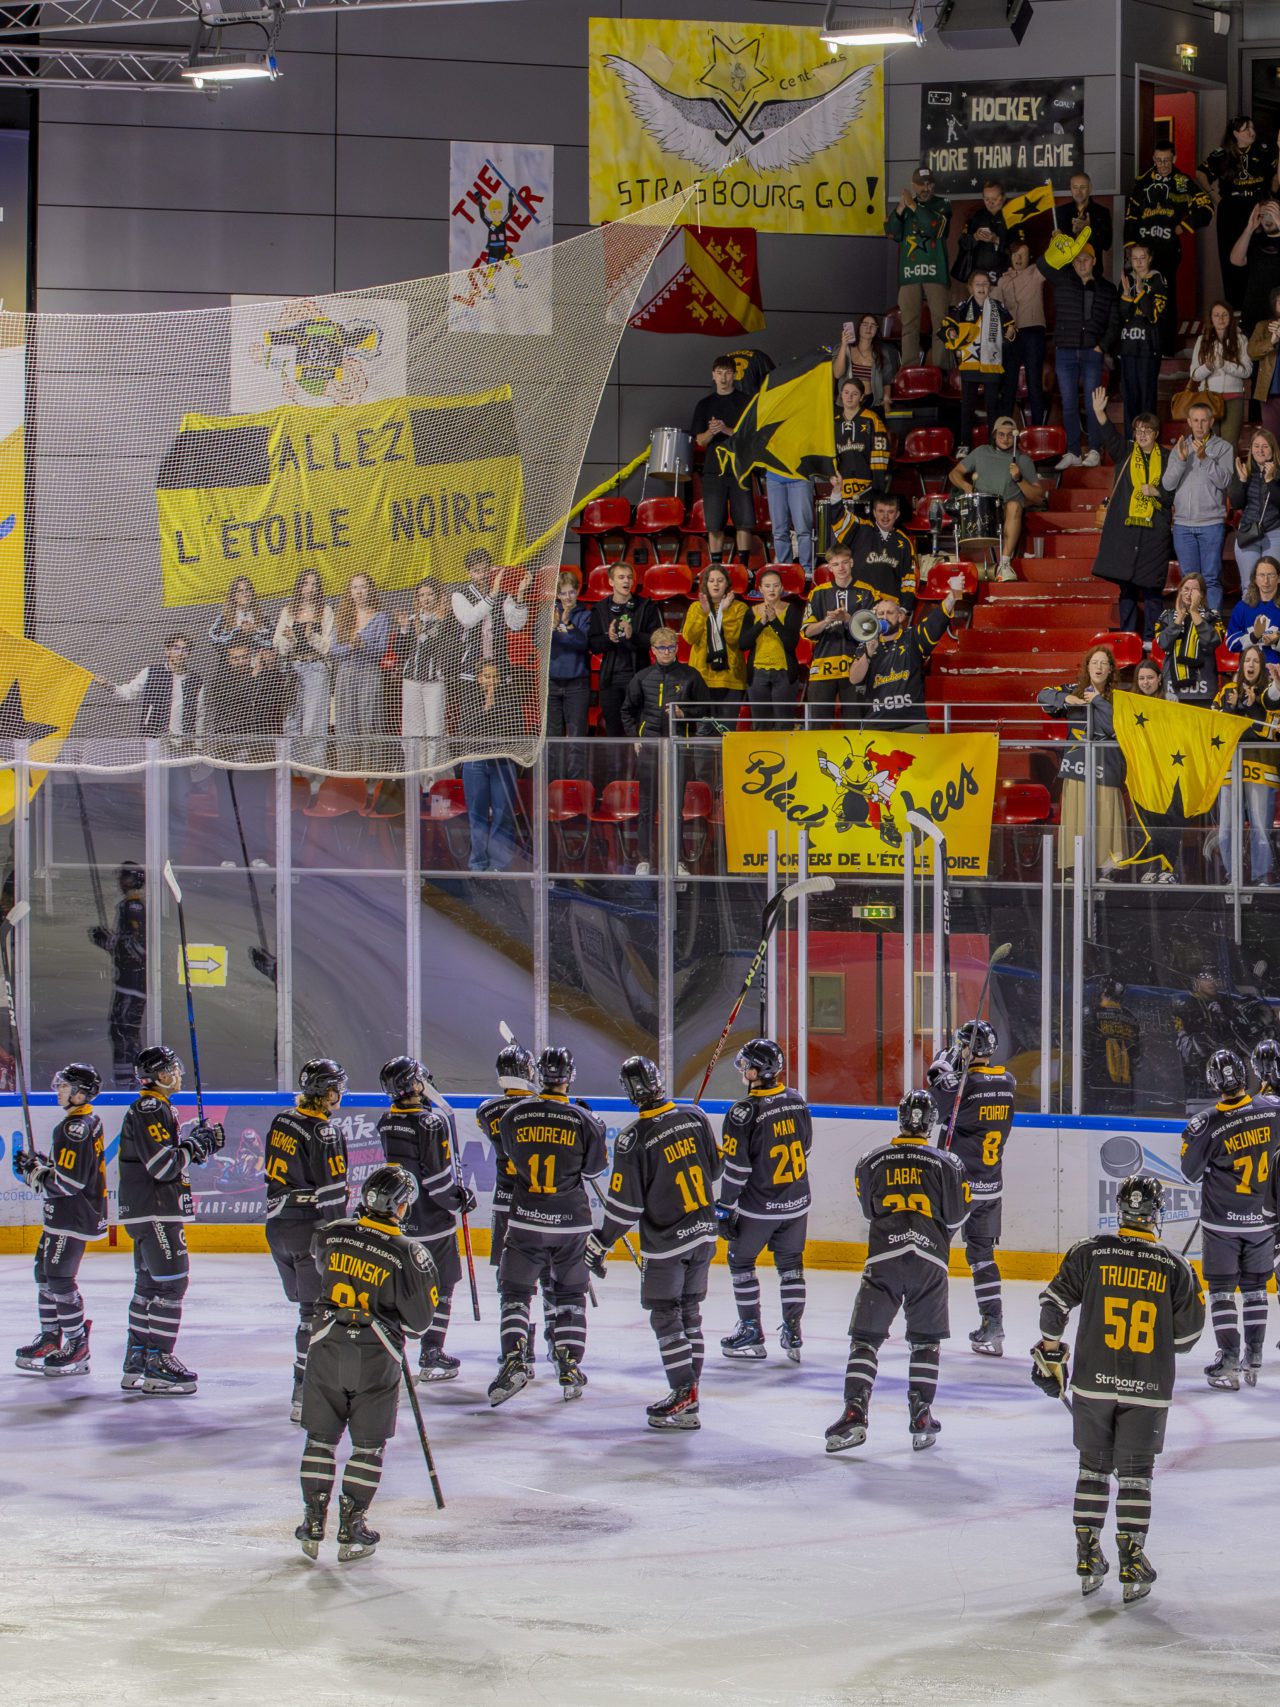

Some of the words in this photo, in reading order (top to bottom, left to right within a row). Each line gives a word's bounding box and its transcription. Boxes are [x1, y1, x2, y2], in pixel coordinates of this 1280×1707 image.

[971, 97, 1042, 122] HOCKEY
[929, 147, 968, 171] MORE
[974, 145, 1012, 169] THAN
[1017, 145, 1027, 168] A
[1034, 143, 1074, 167] GAME
[904, 264, 937, 278] R-GDS
[278, 420, 406, 472] ALLEZ
[392, 487, 497, 542] NOIRE
[873, 694, 913, 712] R-GDS
[1060, 759, 1104, 778] R-GS
[838, 853, 861, 866] DE
[947, 855, 980, 869] OIRE
[979, 1104, 1010, 1121] POIROT
[146, 1123, 171, 1144] 93
[773, 1118, 795, 1137] MAIN
[664, 1137, 697, 1164] DUGAS
[722, 1133, 737, 1157] 28
[982, 1131, 1002, 1166] 8
[1224, 1126, 1271, 1155] MEUNIER
[59, 1147, 77, 1170] 10
[327, 1155, 346, 1177] 16
[769, 1143, 806, 1185] 28
[528, 1153, 558, 1194] 11
[886, 1167, 923, 1187] LABAT
[1227, 1211, 1263, 1222] Strasbo
[344, 1238, 365, 1249] NOIRE
[1112, 1248, 1134, 1257] NOIRE
[1099, 1265, 1167, 1293] TRUDEAU
[1104, 1296, 1158, 1354] 58
